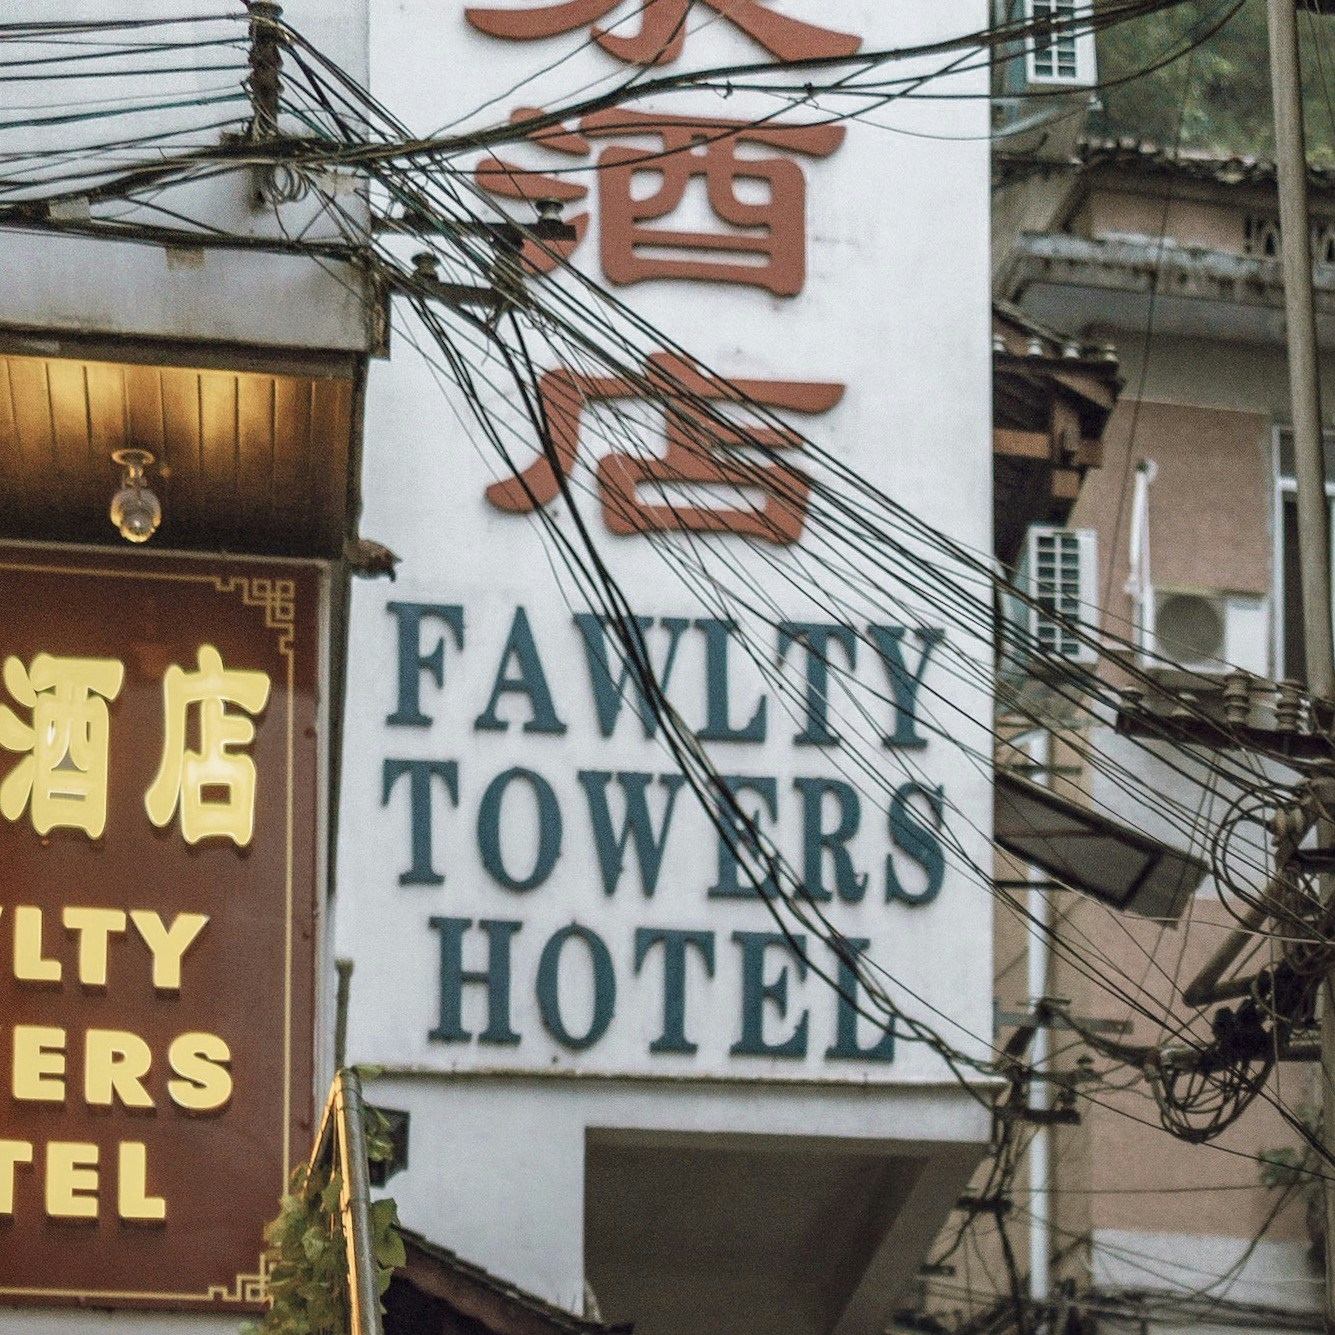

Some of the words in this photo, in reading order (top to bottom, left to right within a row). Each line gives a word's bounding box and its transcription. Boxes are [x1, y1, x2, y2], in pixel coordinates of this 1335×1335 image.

[0, 644, 271, 846] 酒店
[383, 600, 947, 750] FAWLTY
[381, 757, 947, 907] TOWERS
[0, 905, 209, 992] LTY
[427, 914, 897, 1064] HOTEL
